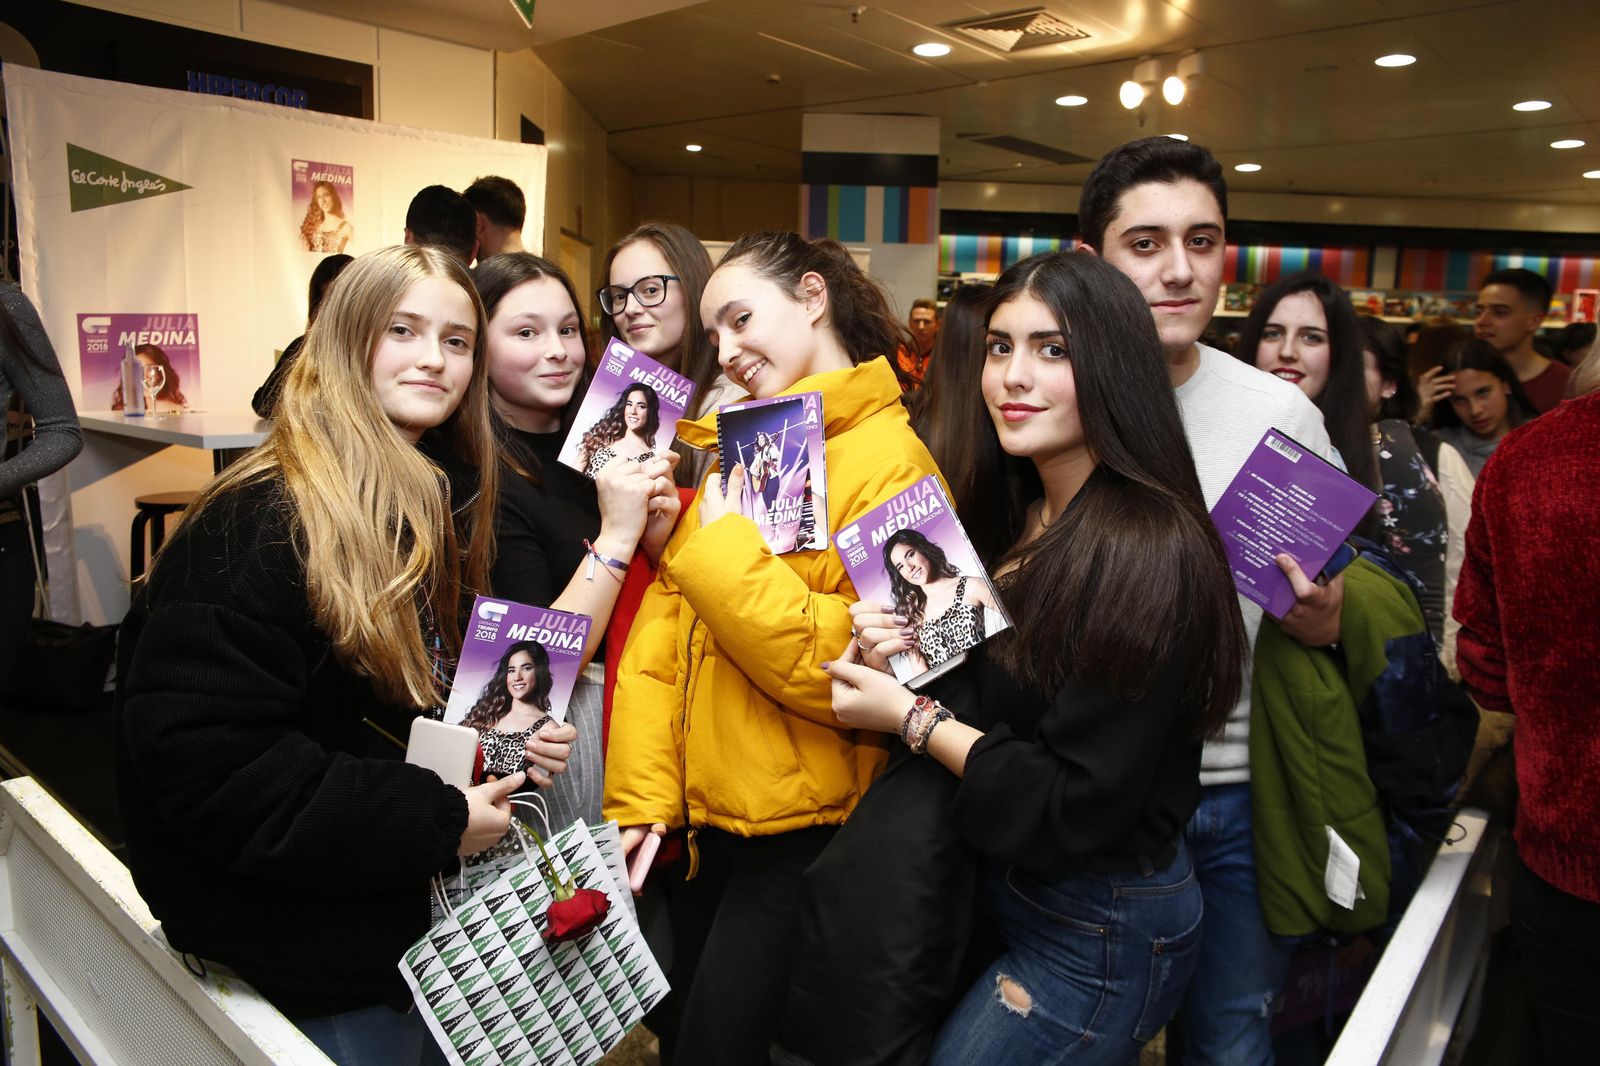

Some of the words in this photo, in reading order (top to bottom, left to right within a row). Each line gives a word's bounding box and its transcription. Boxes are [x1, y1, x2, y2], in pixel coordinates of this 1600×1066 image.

[187, 70, 308, 109] HIPERCOR
[71, 169, 87, 184] El
[87, 172, 120, 187] Corte
[311, 172, 352, 184] MEDINA
[142, 317, 195, 330] JULIA
[118, 331, 196, 346] MEDINA
[629, 367, 687, 407] MEDINA
[652, 367, 692, 395] JULIA
[768, 495, 802, 512] JULIA
[886, 480, 934, 520] JULIA
[871, 495, 941, 547] MEDINA
[849, 552, 868, 566] 2018
[535, 612, 588, 635] JULIA
[475, 630, 496, 640] 2018
[506, 624, 583, 651] MEDINA
[555, 648, 580, 656] CANCIONES
